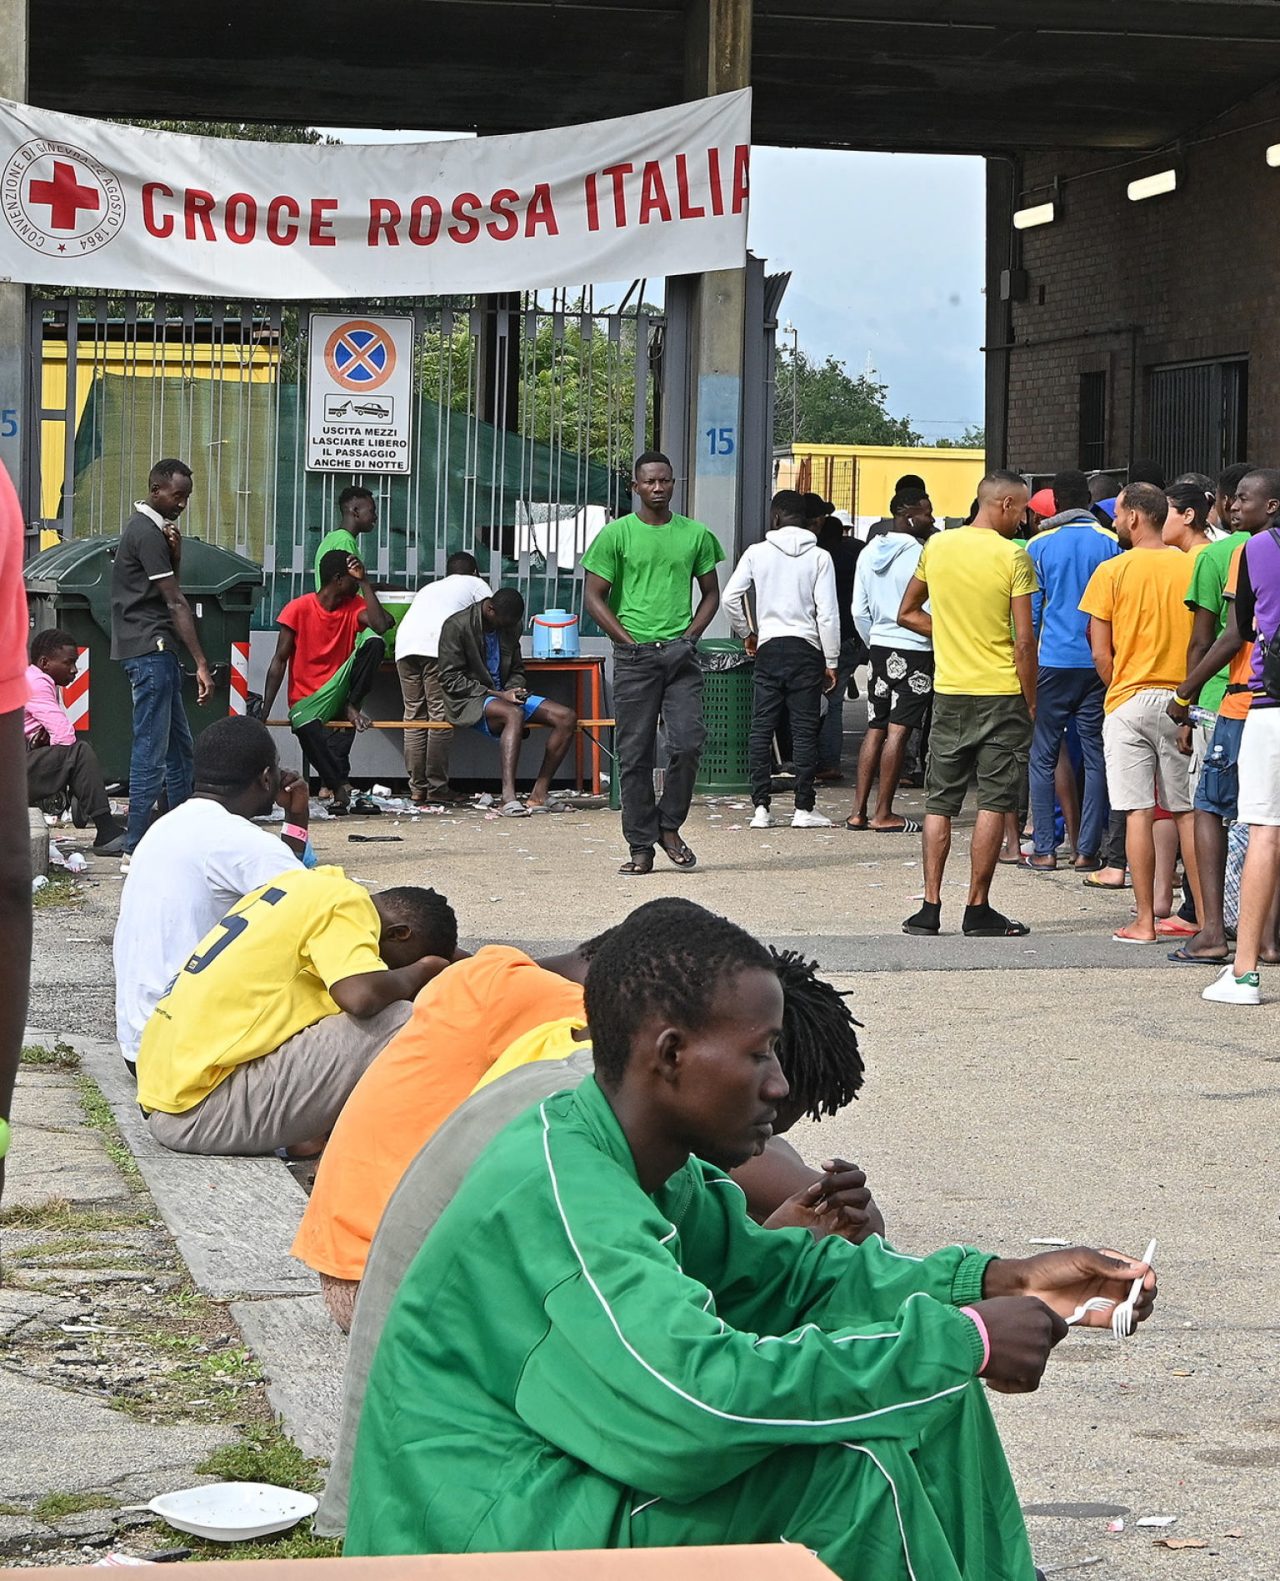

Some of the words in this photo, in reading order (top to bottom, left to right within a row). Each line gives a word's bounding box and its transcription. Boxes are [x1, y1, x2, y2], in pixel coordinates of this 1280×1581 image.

[21, 147, 36, 161] DI
[36, 142, 88, 163] GINEVRA
[5, 160, 46, 248] CONVENZIONE
[103, 178, 122, 227] AGOSTO
[143, 182, 338, 247] CROCE
[368, 183, 559, 246] ROSSA
[585, 144, 749, 232] ITALIA
[80, 228, 110, 250] 1864
[322, 426, 362, 436] USCITA
[364, 428, 397, 437] MEZZI
[705, 427, 734, 456] 15
[312, 437, 365, 447] LASCIARE
[368, 439, 407, 448] LIBERO
[313, 458, 351, 468] ANCHE
[354, 460, 365, 468] DI
[368, 460, 404, 470] NOTTE
[322, 448, 332, 456] IL
[335, 448, 397, 459] PASSAGGIO
